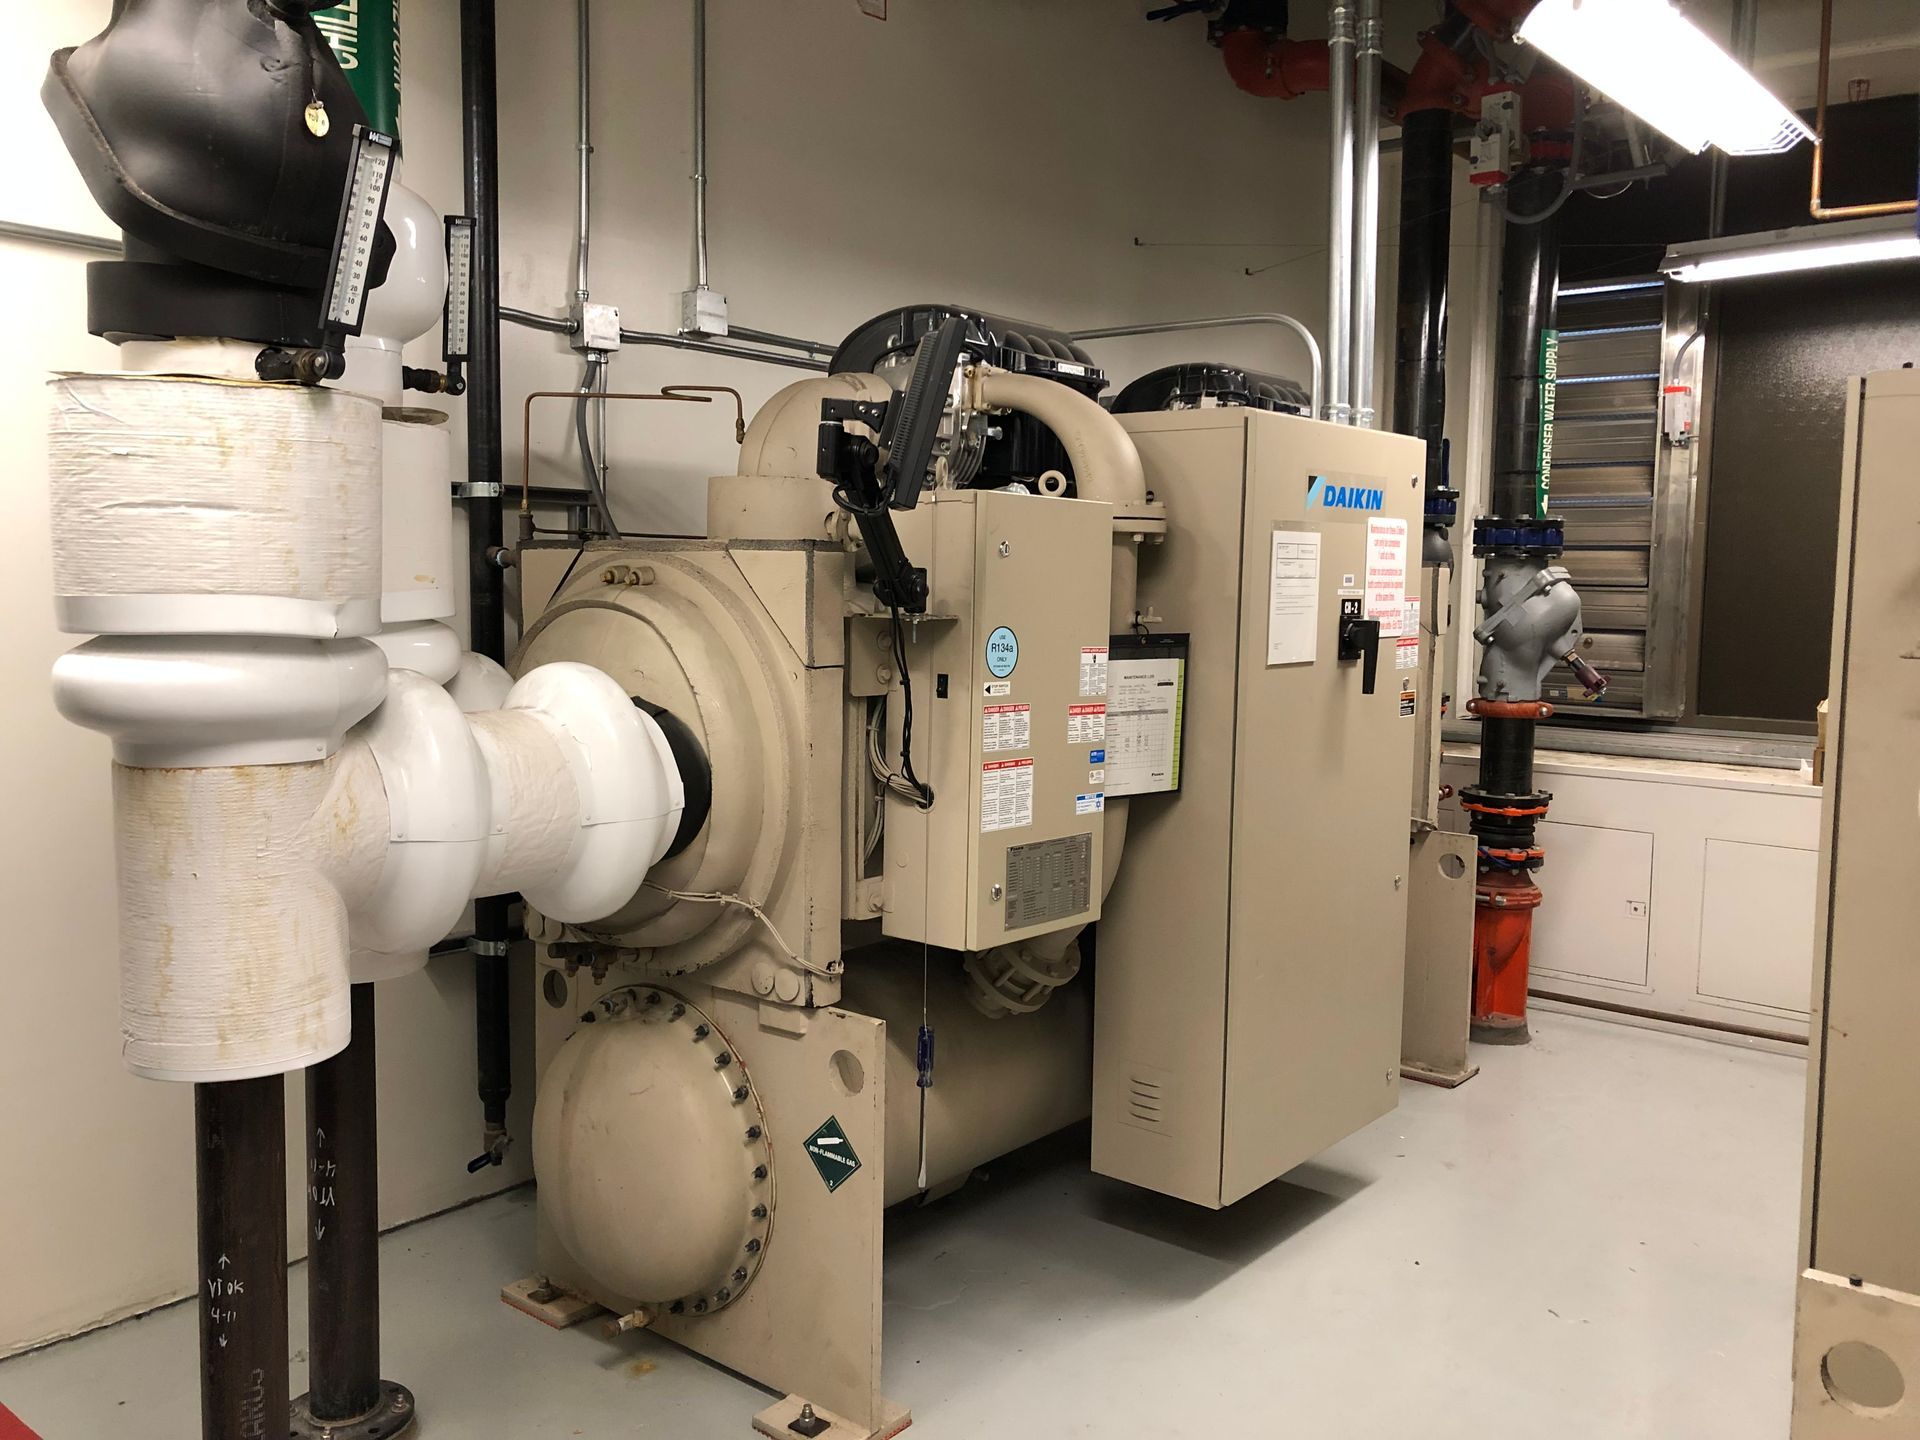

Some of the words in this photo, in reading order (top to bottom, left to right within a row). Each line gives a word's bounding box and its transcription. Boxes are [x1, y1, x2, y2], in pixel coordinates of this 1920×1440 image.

[1545, 337, 1558, 380] SUPPLY
[1544, 382, 1556, 421] WATER
[1541, 423, 1554, 489] CONDENSER
[1323, 485, 1383, 511] DAIKIN
[991, 643, 1014, 653] R134a
[809, 1144, 846, 1164] NON-FLAMMABLE
[846, 1158, 856, 1167] GAS
[227, 1279, 244, 1296] OK
[211, 1307, 236, 1324] 4-11
